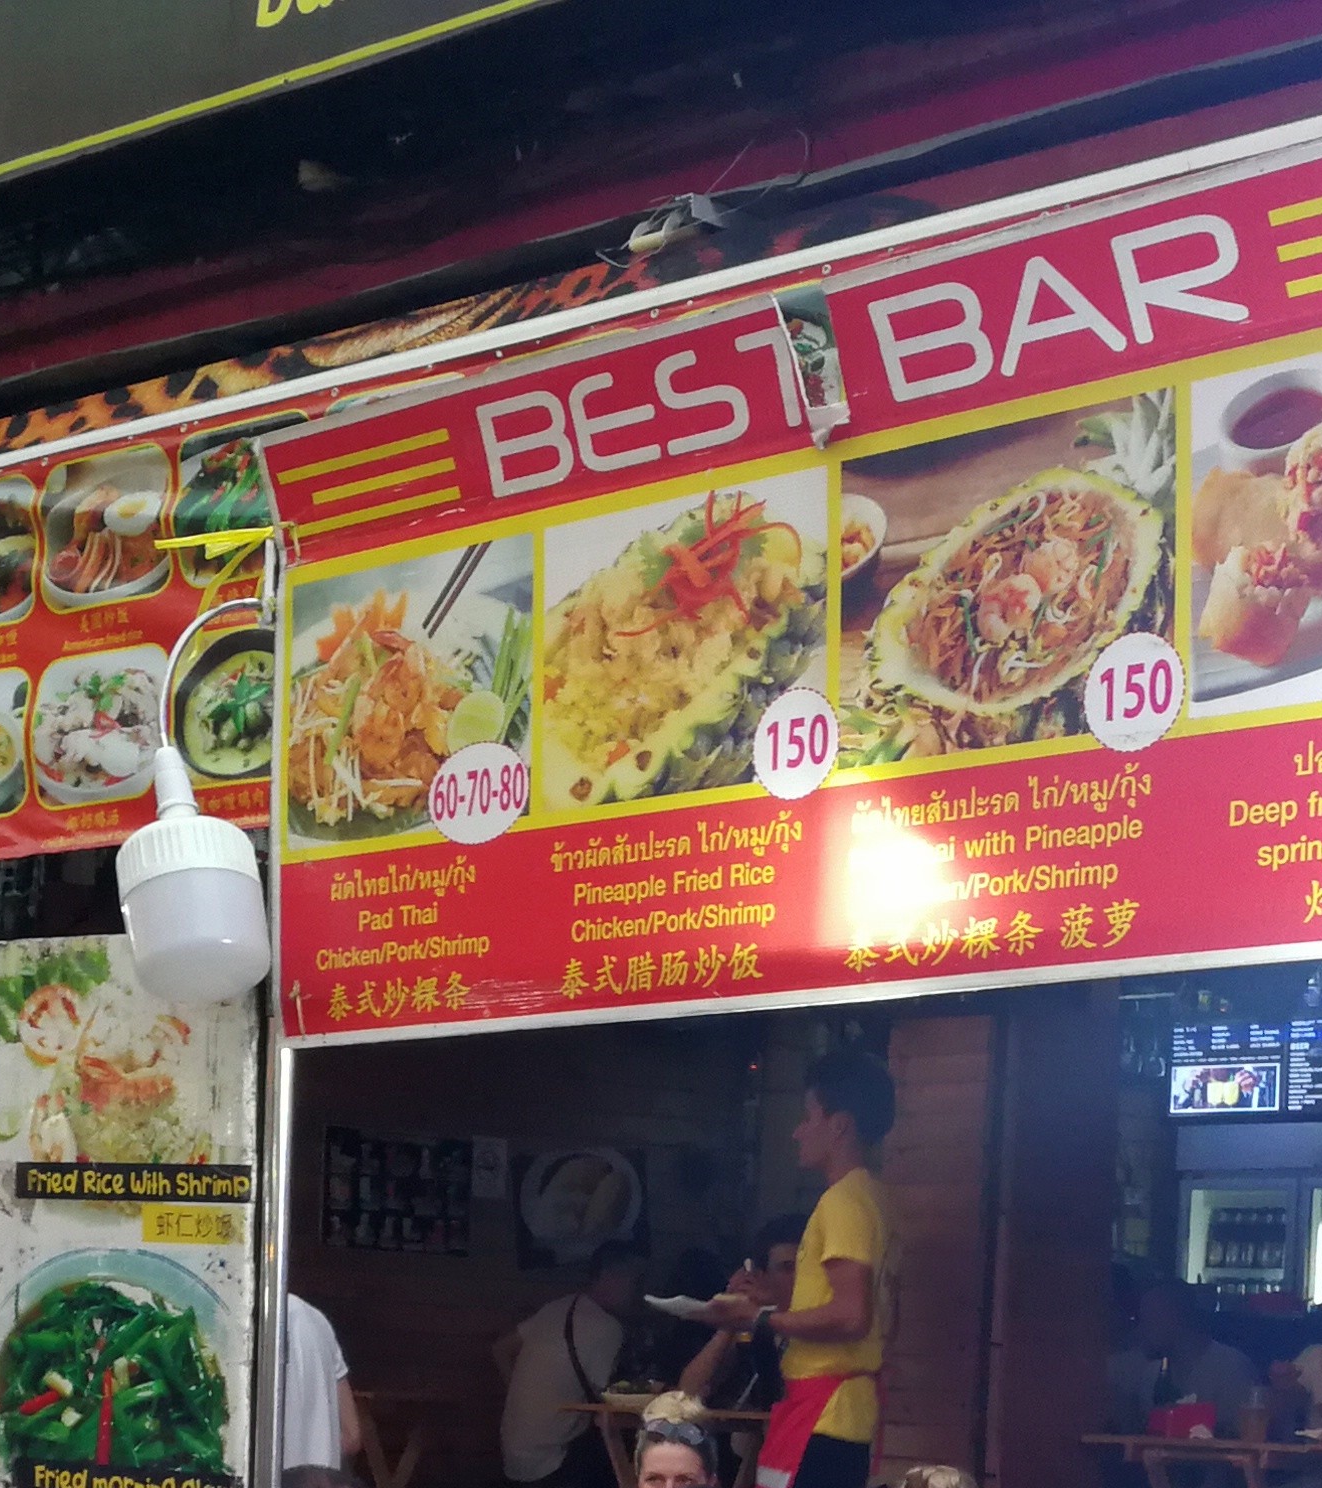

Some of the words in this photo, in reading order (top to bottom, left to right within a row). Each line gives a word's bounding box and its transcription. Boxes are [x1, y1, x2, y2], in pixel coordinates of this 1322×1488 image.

[475, 326, 801, 499] BEST
[867, 212, 1250, 403] BAR
[1098, 657, 1174, 723] 150
[767, 712, 830, 773] 150
[432, 760, 526, 823] 60-70-80
[1229, 799, 1298, 827] Deep
[964, 830, 1015, 859] with
[1025, 814, 1143, 856] Pineapple
[573, 875, 666, 907] Pineapple
[673, 867, 722, 896] Fried
[729, 862, 776, 888] Rice
[359, 909, 394, 932] Pad
[399, 902, 440, 926] Thai
[570, 898, 776, 945] Chicken/Pork/Shrimp
[1061, 897, 1140, 950] 菠萝
[315, 932, 490, 971] Chicken/Pork/Shrimp
[560, 942, 764, 1002] 泰式腊肠炒饭
[326, 970, 472, 1022] 泰式炒粿条
[27, 1169, 79, 1194] Fried
[83, 1170, 124, 1195] Rice
[176, 1172, 250, 1198] Shrimp
